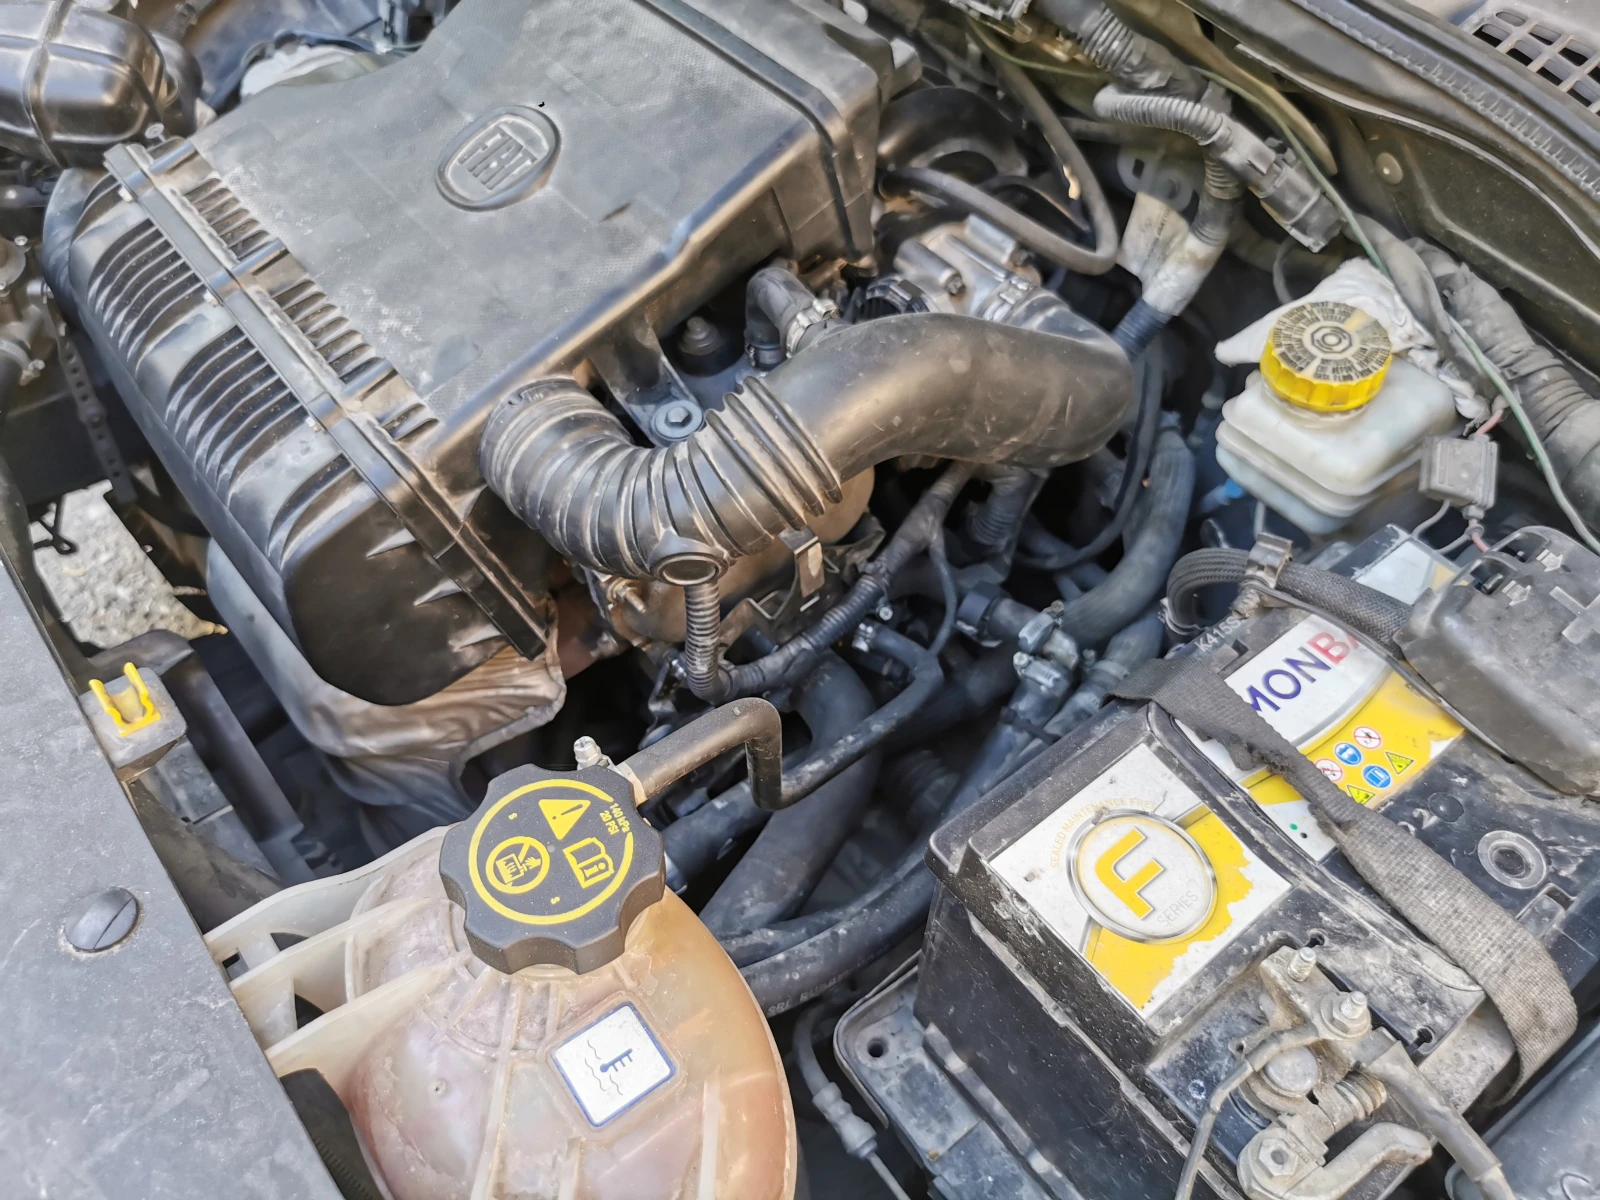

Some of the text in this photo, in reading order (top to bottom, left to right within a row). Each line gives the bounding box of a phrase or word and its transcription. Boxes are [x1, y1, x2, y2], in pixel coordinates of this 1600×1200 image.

[457, 123, 538, 191] FIAT
[1246, 631, 1360, 712] MONB
[599, 810, 620, 835] 20 PSI
[610, 803, 630, 833] 140 kPa
[1050, 797, 1158, 868] SEALED MAINTENANCE FREE
[1094, 826, 1164, 921] F
[1157, 890, 1199, 927] SERIES
